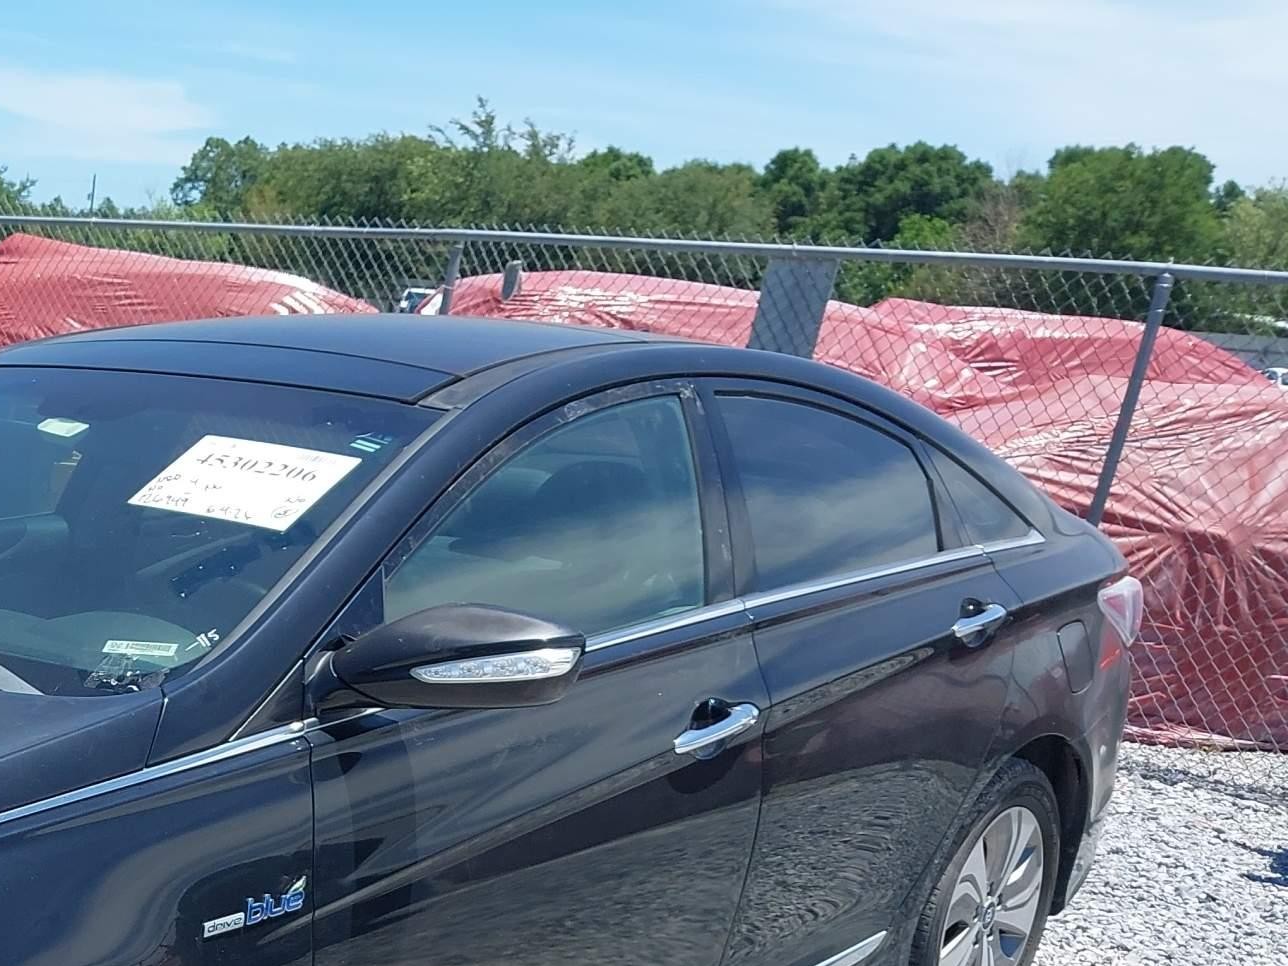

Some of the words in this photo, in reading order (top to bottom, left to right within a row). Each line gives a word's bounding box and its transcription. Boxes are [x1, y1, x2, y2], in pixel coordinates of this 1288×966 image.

[196, 452, 317, 482] 45302206
[206, 917, 243, 934] drive
[246, 889, 306, 925] blue
